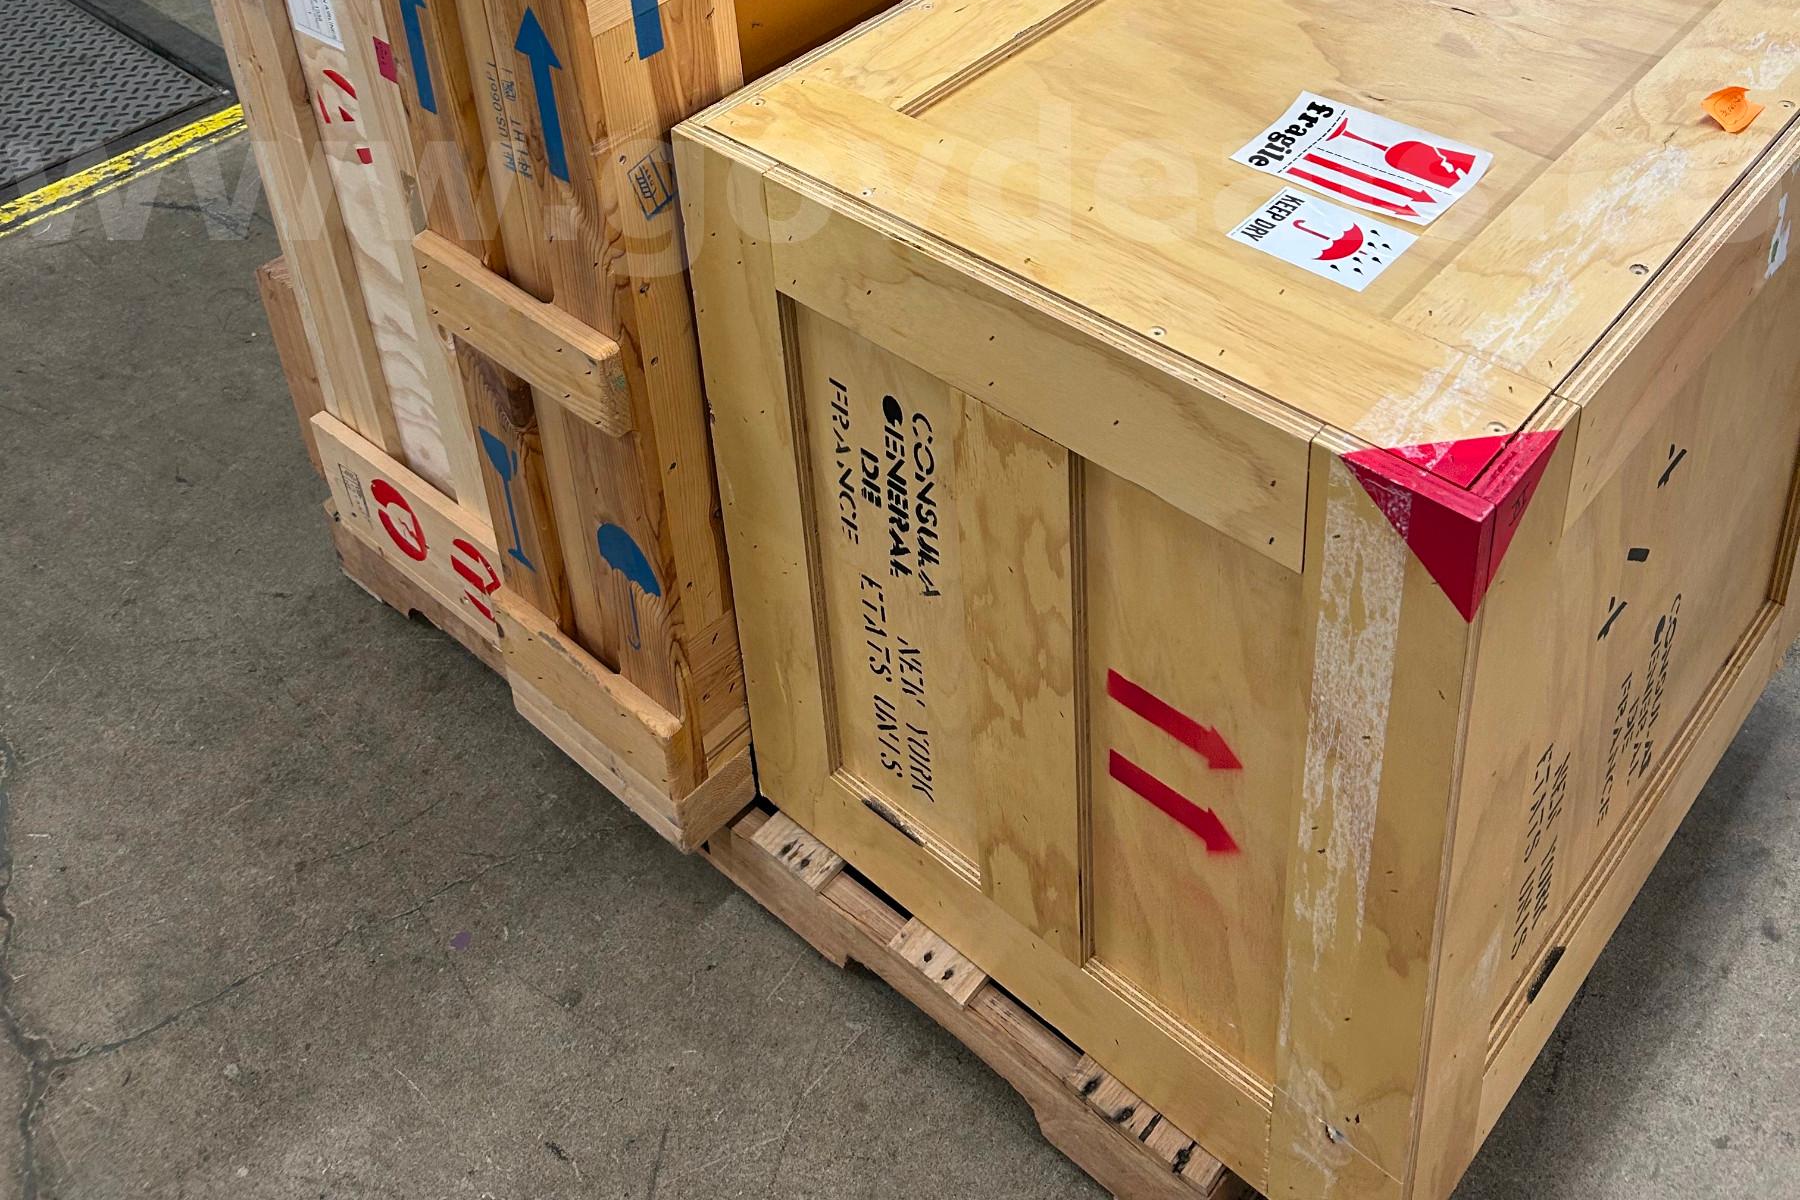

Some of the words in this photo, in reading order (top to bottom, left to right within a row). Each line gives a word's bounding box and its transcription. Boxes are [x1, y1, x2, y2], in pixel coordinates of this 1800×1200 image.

[1240, 217, 1277, 243] DRY
[1265, 194, 1306, 222] KEEP
[828, 375, 860, 545] FRANCE
[859, 446, 882, 511] DE
[858, 571, 894, 686] ETATS
[904, 720, 936, 804] YORK
